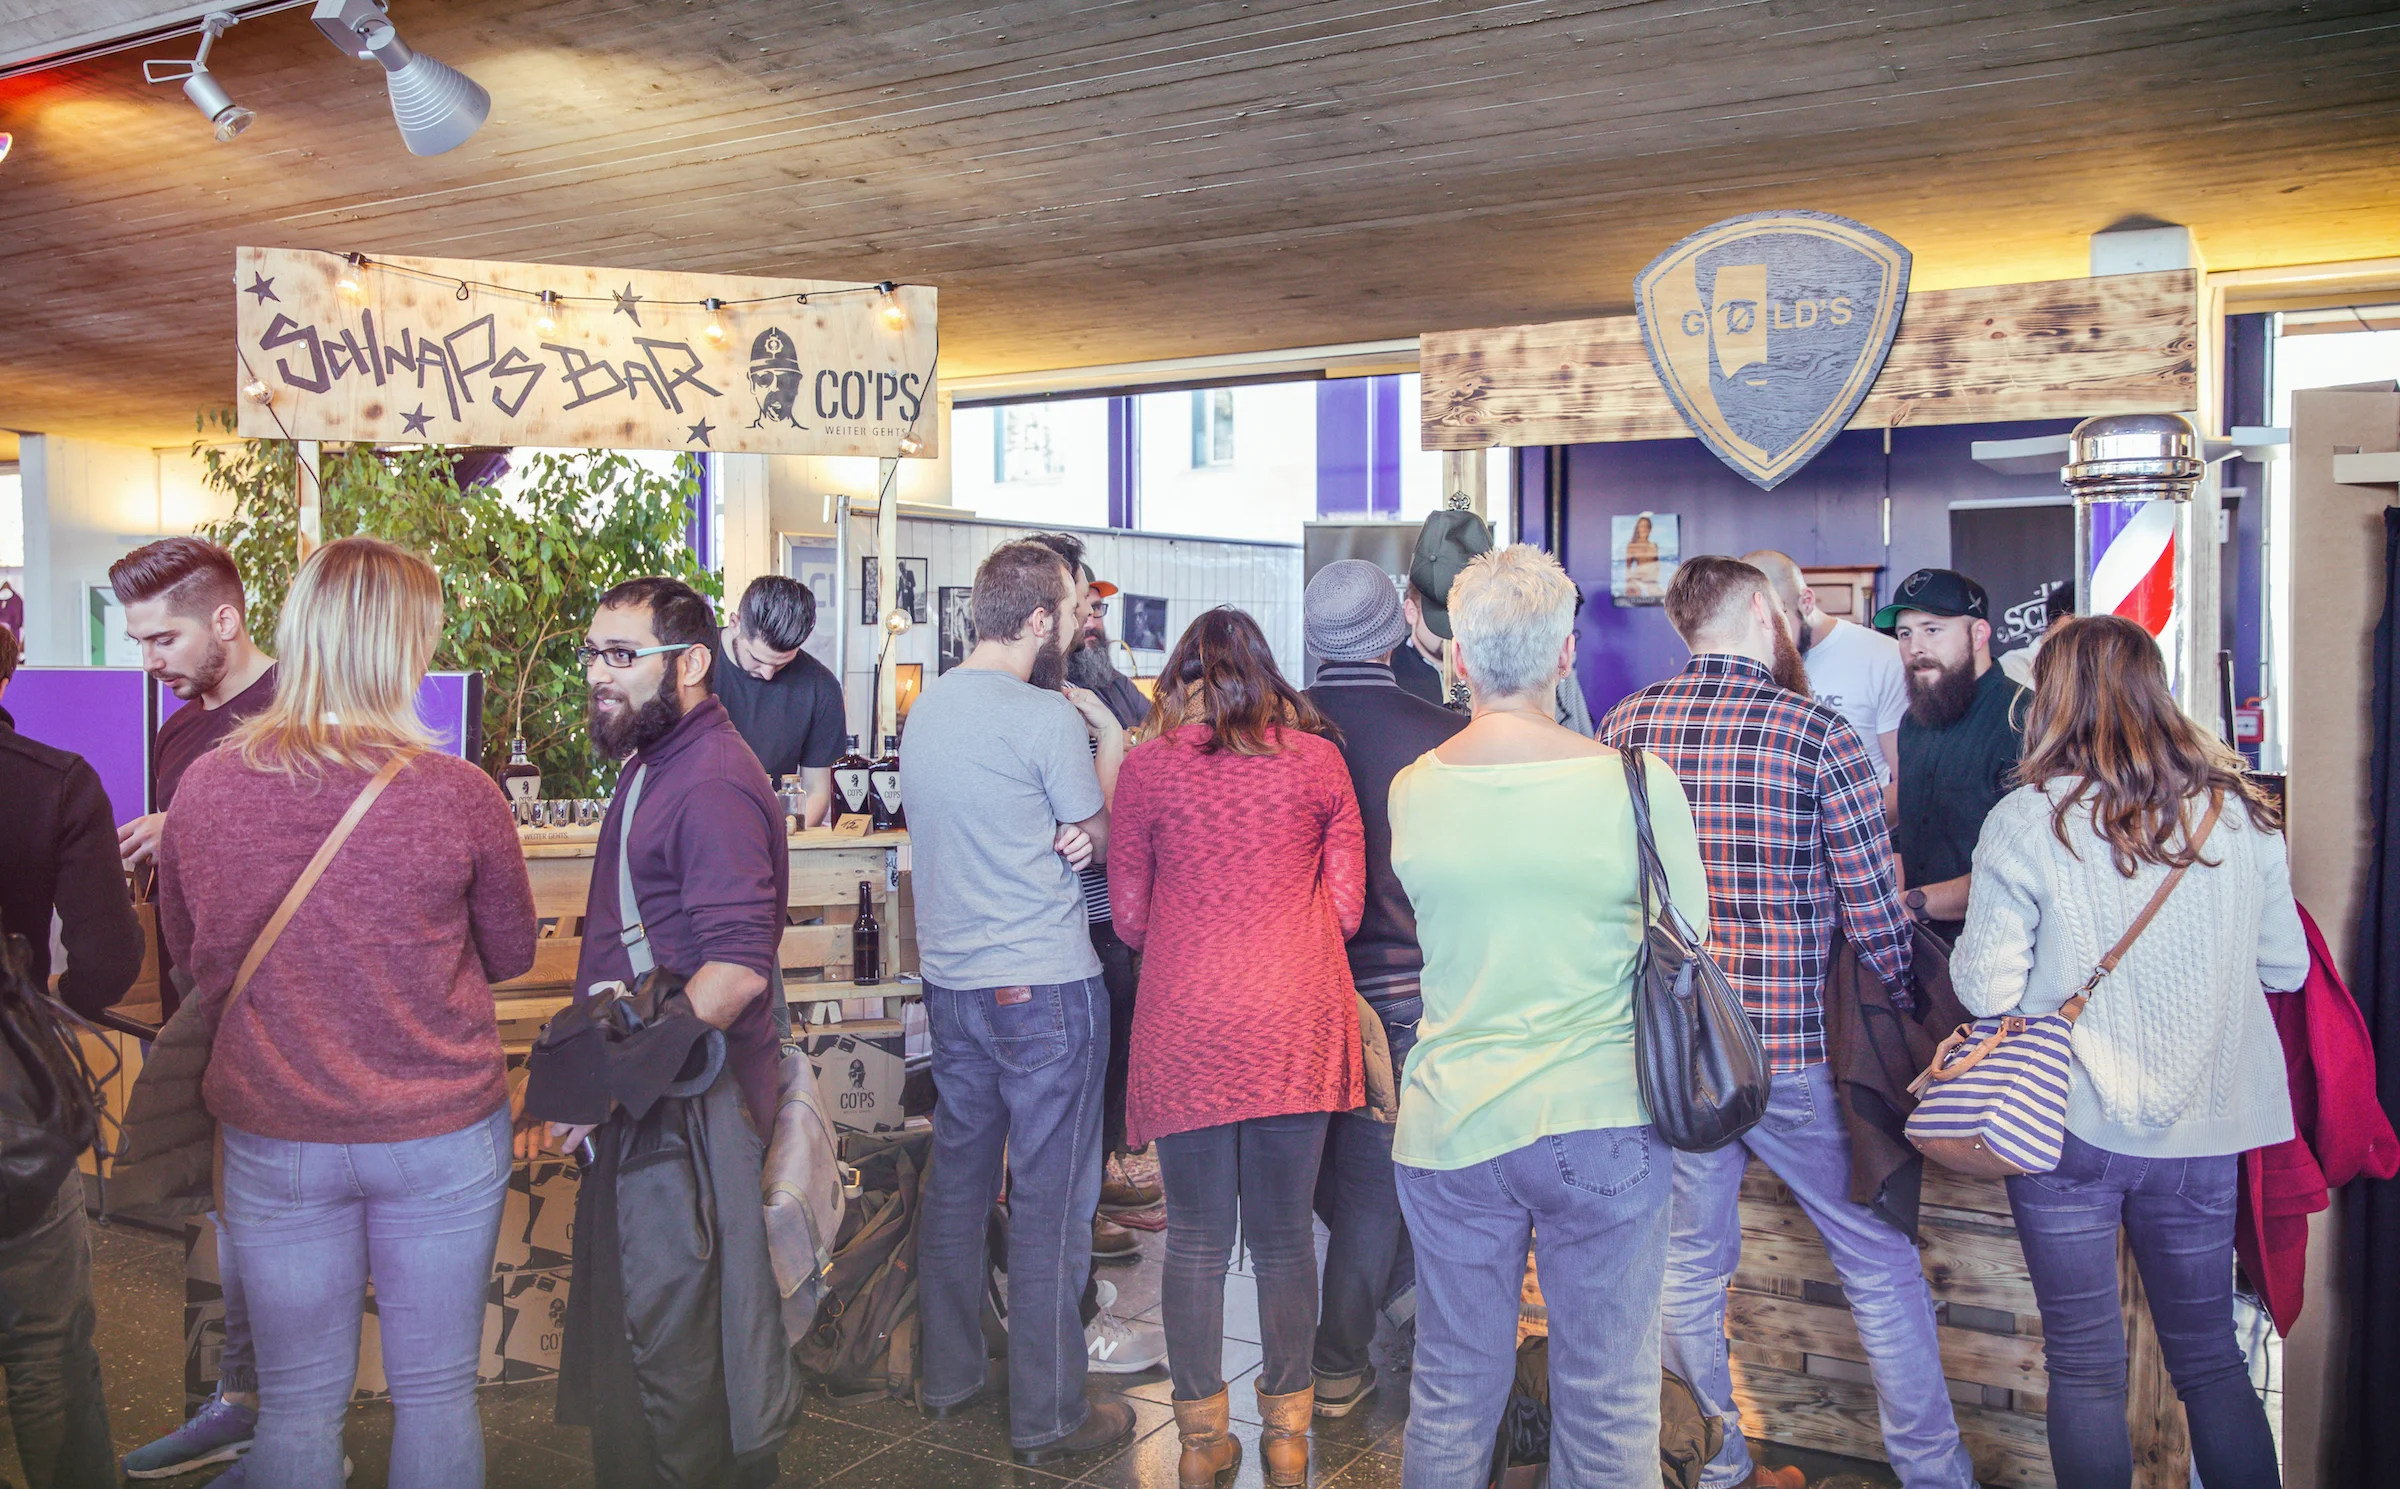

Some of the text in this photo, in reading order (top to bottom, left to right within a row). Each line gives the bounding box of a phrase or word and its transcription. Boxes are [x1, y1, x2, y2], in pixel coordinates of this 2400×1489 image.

[259, 308, 724, 422] SCHNAPS BAR
[815, 369, 920, 421] CO'PS
[825, 426, 866, 436] WEITER
[840, 1091, 875, 1109] CO'PS
